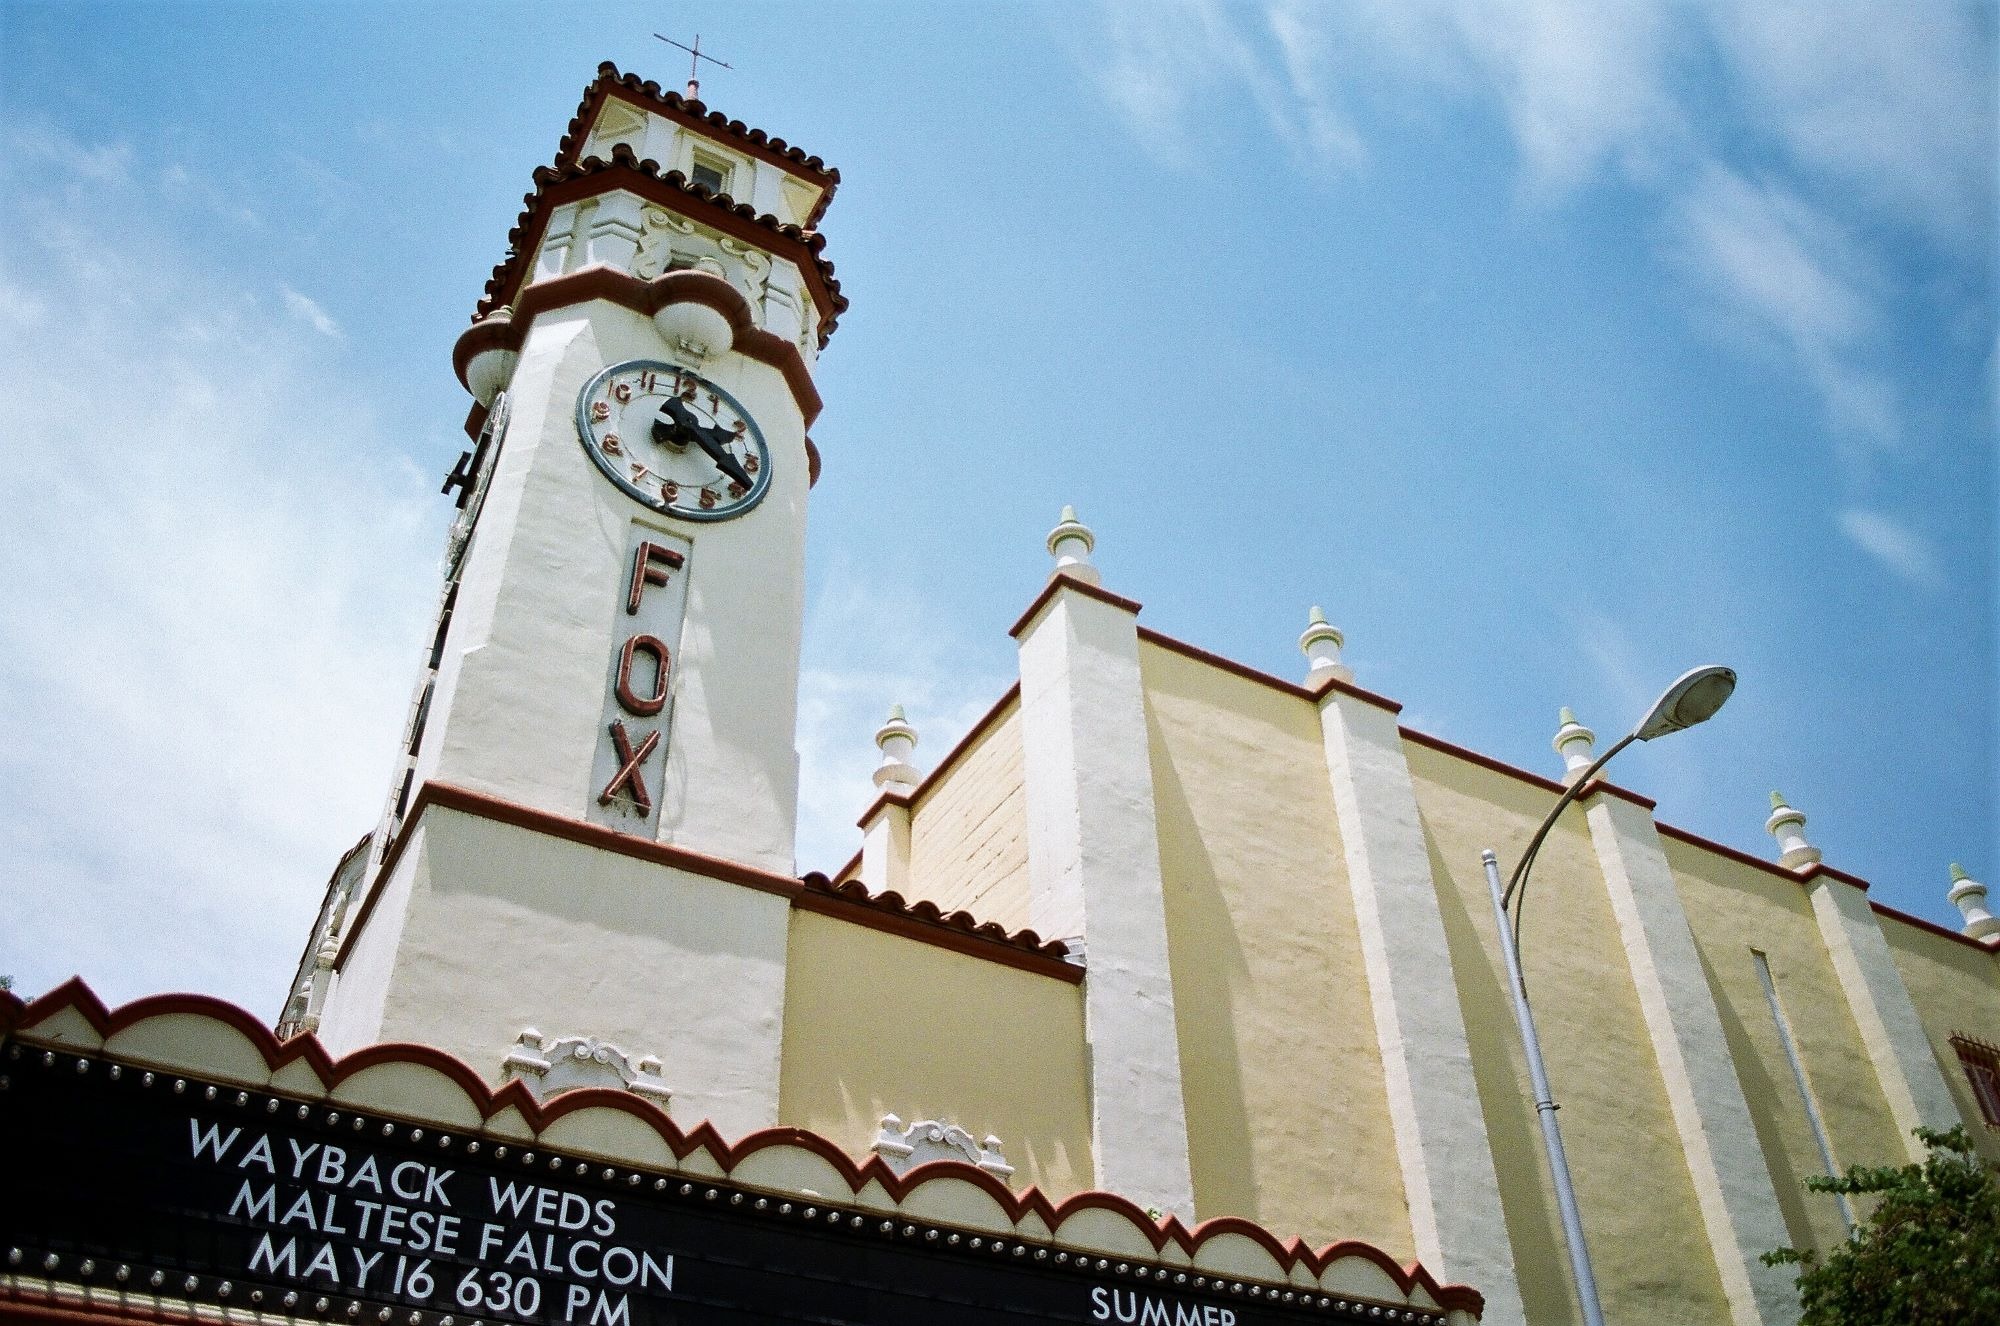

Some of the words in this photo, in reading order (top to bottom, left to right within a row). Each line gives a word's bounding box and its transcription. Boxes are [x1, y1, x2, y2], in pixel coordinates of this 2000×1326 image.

[641, 370, 656, 394] 11
[673, 374, 698, 401] 12
[707, 393, 720, 415] 1
[631, 462, 649, 483] 7
[598, 541, 684, 816] FOX
[190, 1117, 456, 1207] WAYBACK
[489, 1176, 616, 1238] WEDS
[228, 1179, 461, 1255] MALTESE
[479, 1223, 675, 1292] FALCON
[247, 1231, 385, 1289] MAY
[393, 1255, 435, 1299] 16
[456, 1267, 541, 1317] 630
[565, 1284, 630, 1326] PM
